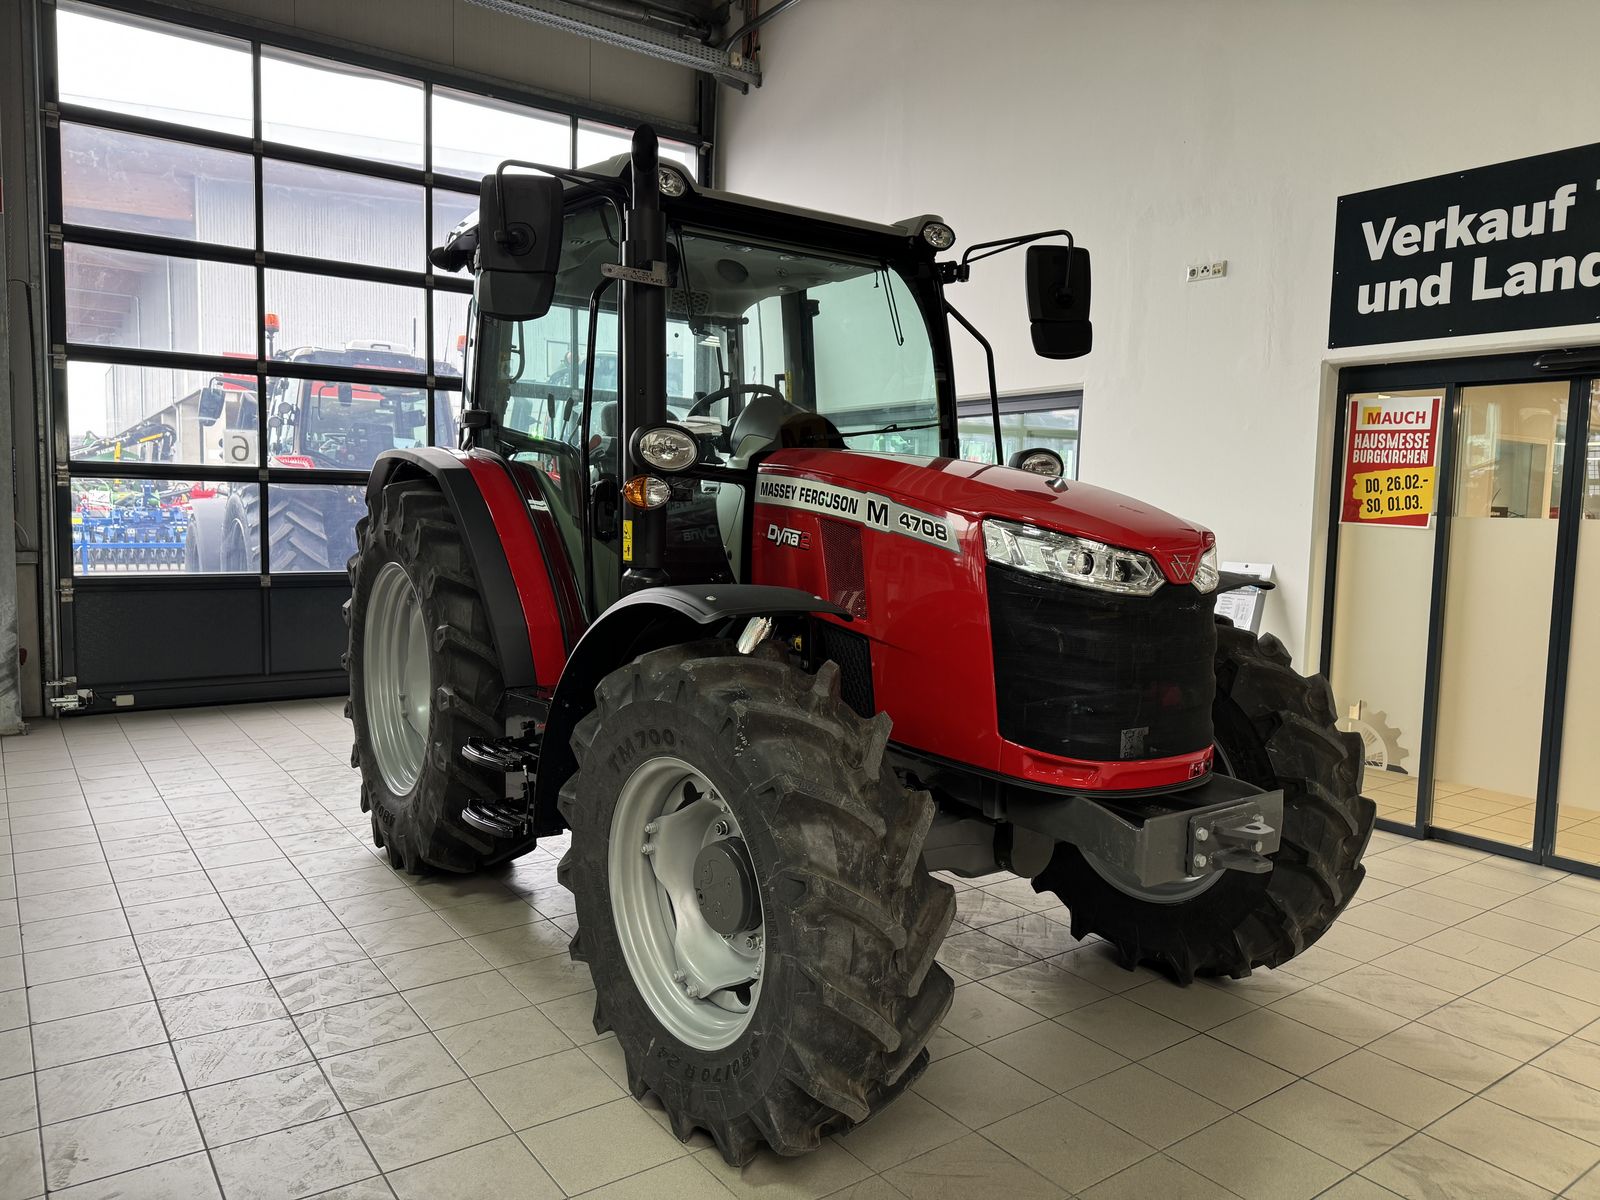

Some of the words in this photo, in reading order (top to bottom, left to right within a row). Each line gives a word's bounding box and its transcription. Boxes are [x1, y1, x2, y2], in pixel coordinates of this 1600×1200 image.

[1361, 183, 1578, 262] Verkauf
[1357, 261, 1453, 315] und
[1366, 410, 1427, 425] MAUCH
[1354, 432, 1431, 449] HAUSMESSE
[1352, 449, 1429, 464] BURGKIRCHEN
[1365, 477, 1383, 495] DO,
[760, 481, 797, 500] MASSEY
[798, 487, 858, 515] FERGUSON
[867, 500, 889, 527] M
[899, 512, 948, 542] 4708
[1366, 498, 1384, 514] SO,
[1387, 494, 1423, 511] 01.03.
